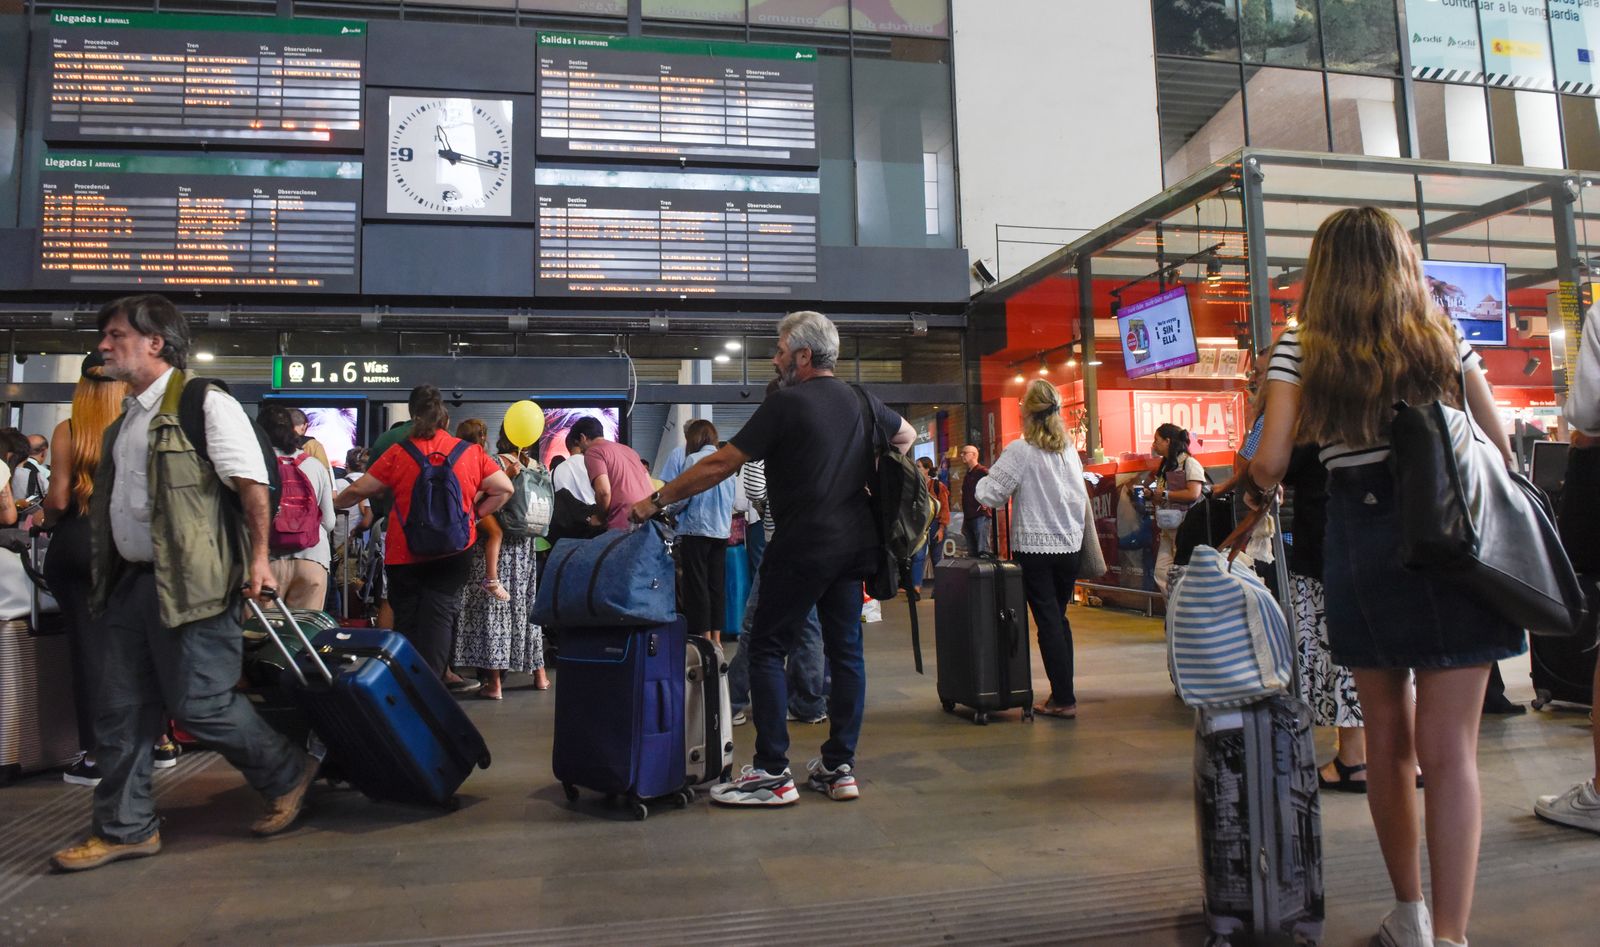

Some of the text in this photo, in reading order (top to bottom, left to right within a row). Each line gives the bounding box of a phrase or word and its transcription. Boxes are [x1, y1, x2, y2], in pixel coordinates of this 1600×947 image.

[1499, 3, 1506, 13] a
[1508, 1, 1518, 14] la
[55, 13, 97, 24] Llegadas
[541, 35, 571, 45] Salidas
[1422, 35, 1442, 43] adif
[746, 69, 780, 77] Observaciones
[398, 147, 502, 166] 9 3
[45, 158, 87, 169] Llegadas
[311, 360, 389, 383] 1 a 6 Vías
